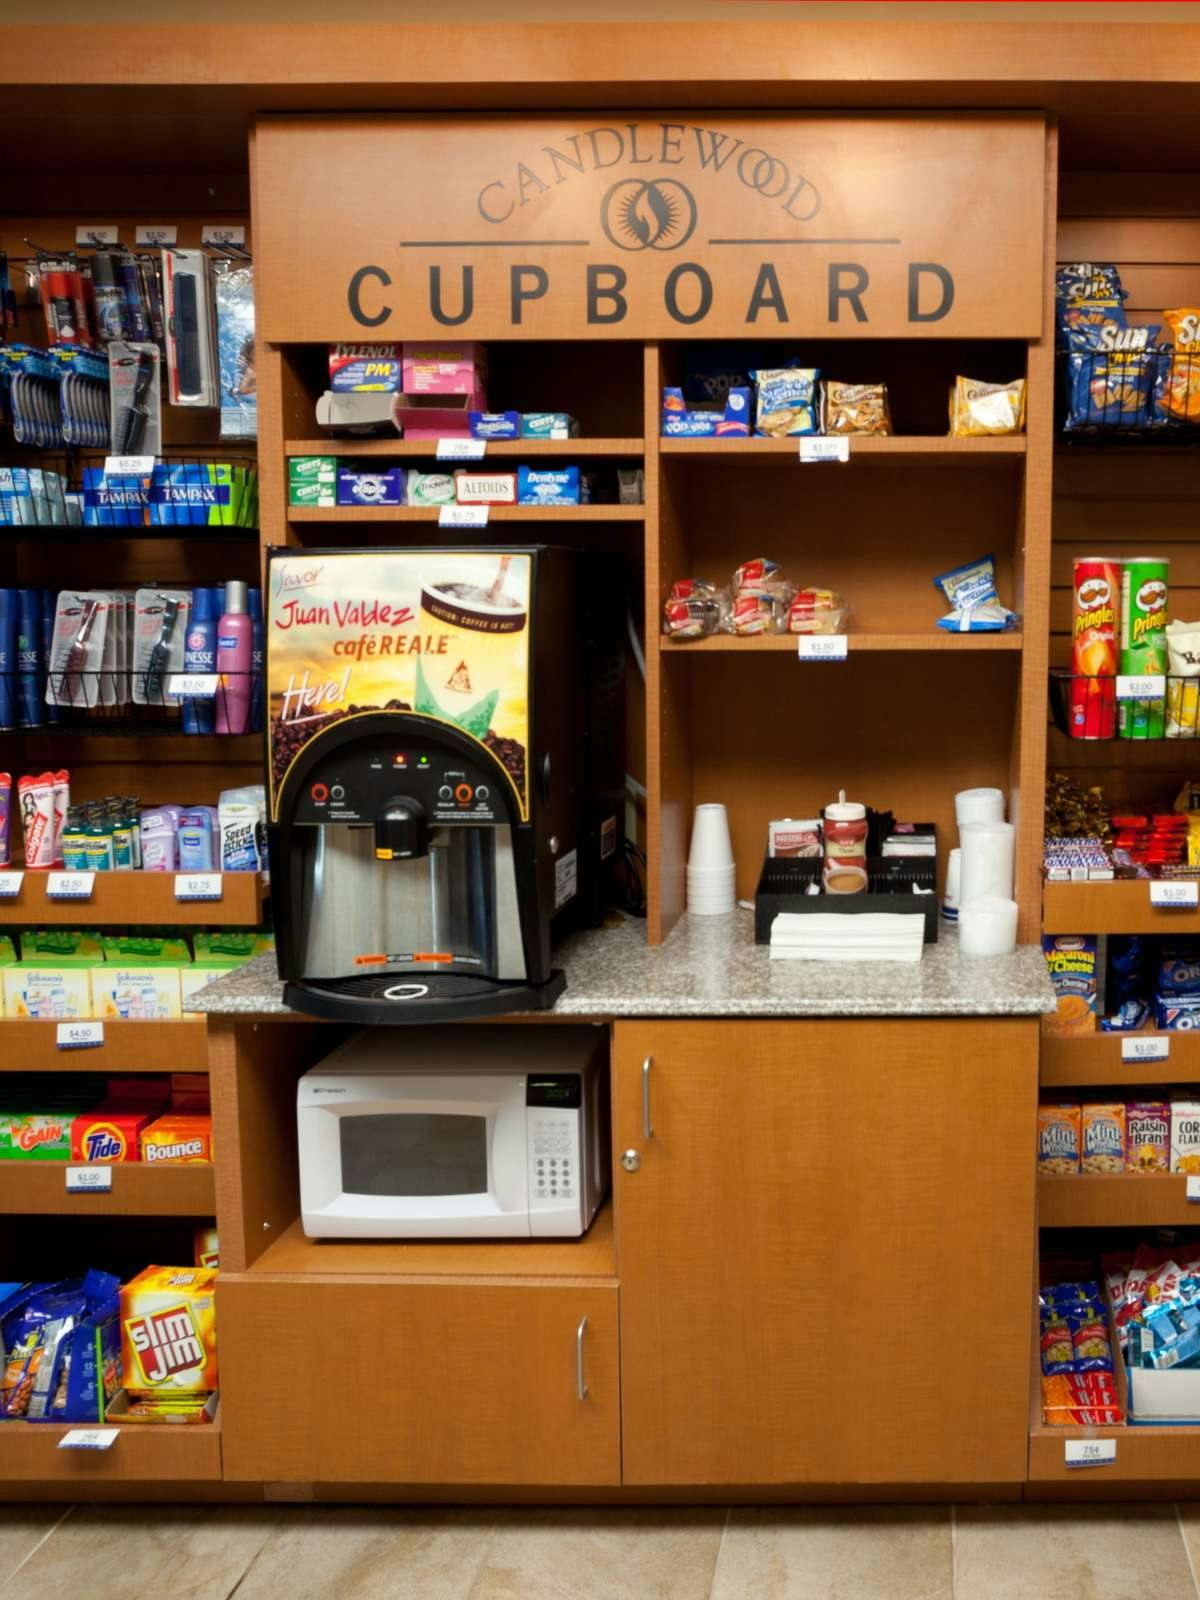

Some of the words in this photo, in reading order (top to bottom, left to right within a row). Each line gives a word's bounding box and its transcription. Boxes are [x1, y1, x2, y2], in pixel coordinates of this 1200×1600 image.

[477, 123, 823, 224] CANDLEWOOD
[347, 262, 956, 328] CUPBOARD
[1097, 325, 1149, 351] Sun
[335, 343, 397, 360] TYLENOL
[364, 363, 393, 377] PM
[162, 488, 216, 501] TAMPAX
[463, 482, 509, 495] ALTOIDS
[97, 491, 149, 504] TAMPAX
[275, 564, 325, 597] Savor
[275, 600, 330, 630] Juan
[334, 600, 416, 629] Valdez
[1074, 604, 1116, 637] Pringles
[281, 666, 352, 722] Here!
[26, 817, 46, 863] Colgate
[60, 879, 82, 888] $2.50
[1045, 949, 1096, 965] Macaroni
[1054, 960, 1094, 974] Cheese
[69, 1029, 91, 1038] $4.50
[1134, 1044, 1158, 1053] $1.00
[1130, 1119, 1168, 1134] Raisin
[19, 1124, 63, 1151] GAIN
[1134, 1133, 1164, 1145] Bran
[87, 1132, 121, 1161] Tide
[146, 1140, 202, 1161] Bounce
